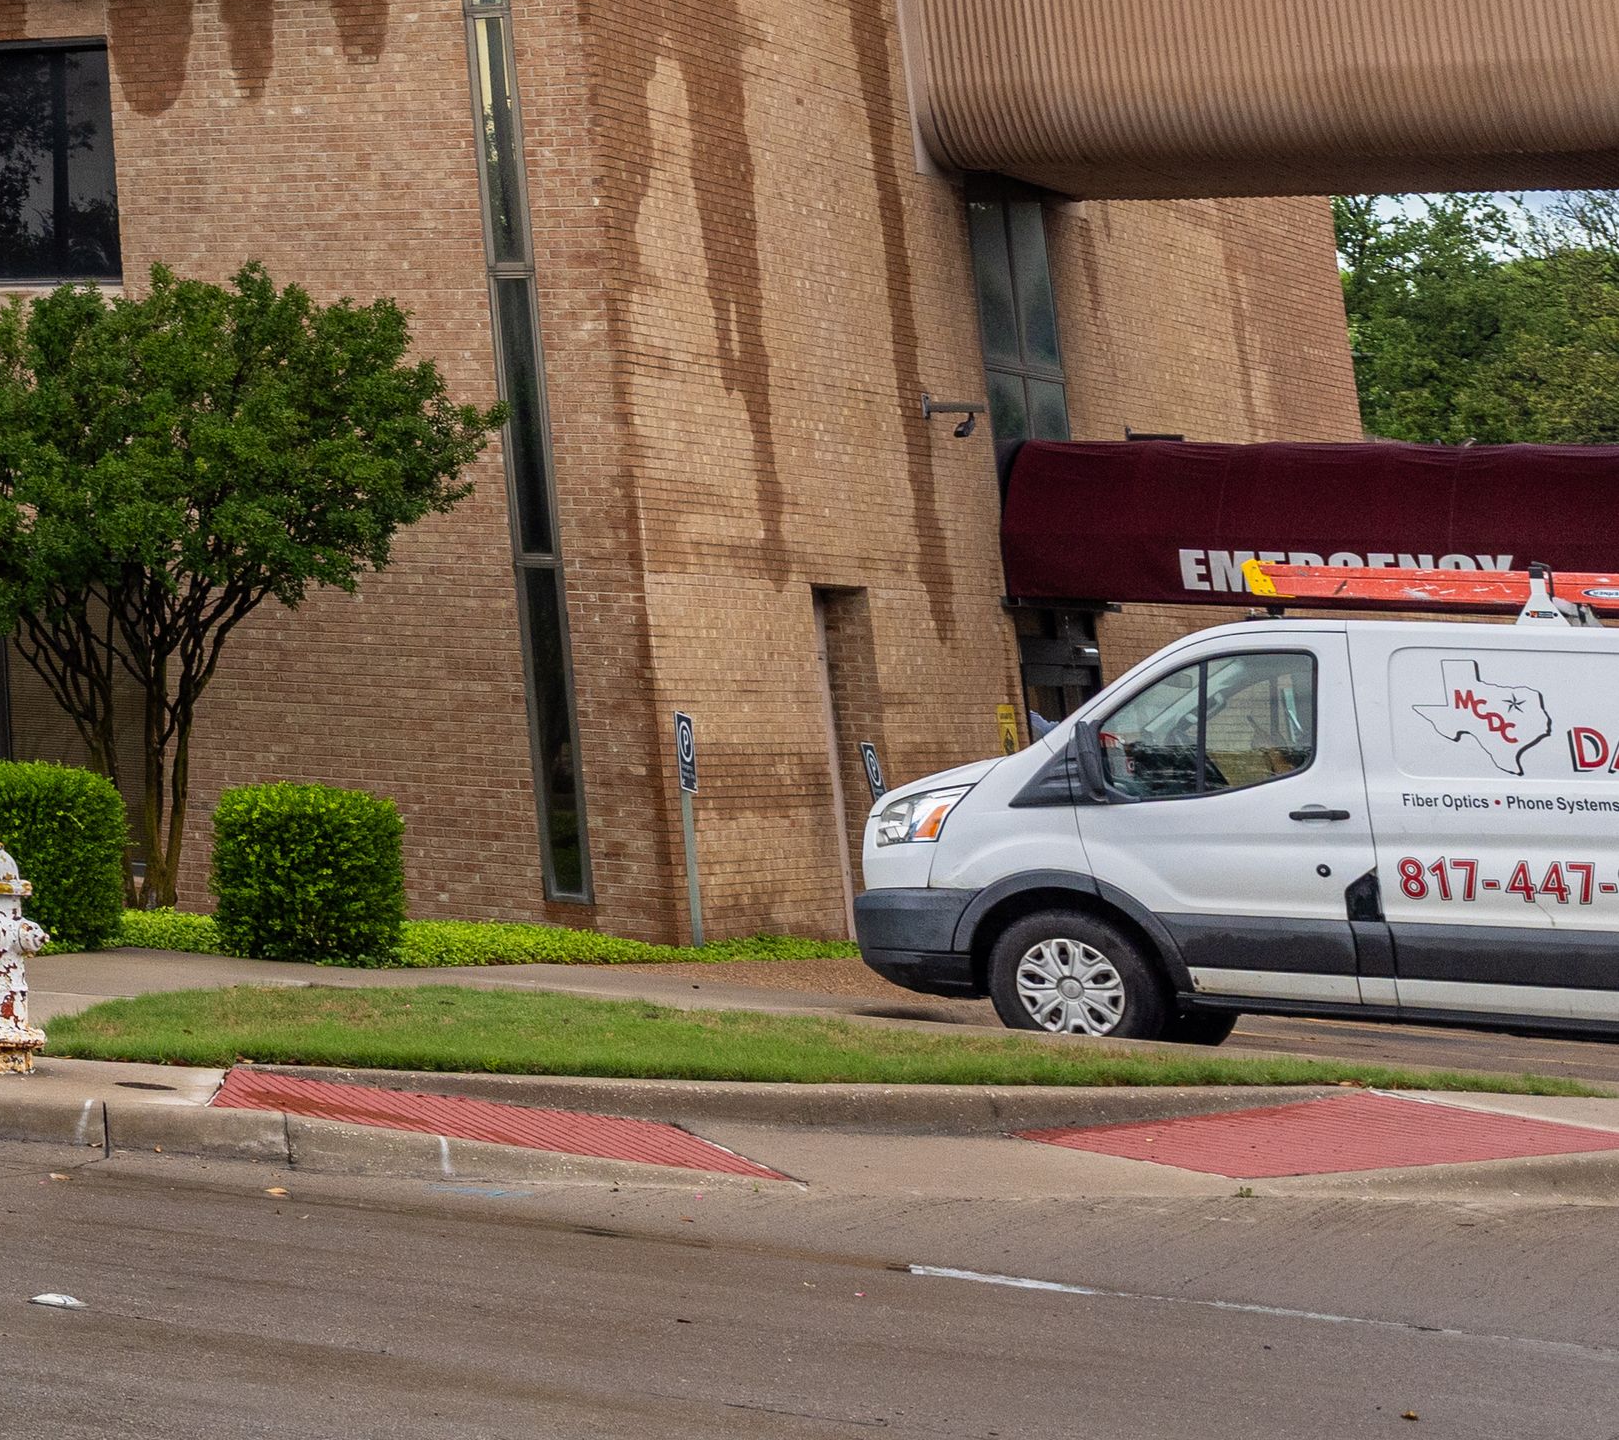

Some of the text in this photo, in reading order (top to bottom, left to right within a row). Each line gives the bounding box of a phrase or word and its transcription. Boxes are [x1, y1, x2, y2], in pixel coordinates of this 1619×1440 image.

[1454, 689, 1519, 744] MCDC
[1567, 726, 1619, 775] D
[1401, 793, 1619, 814] Fiber Optics Phone Systems
[1397, 856, 1619, 905] 817-447-
